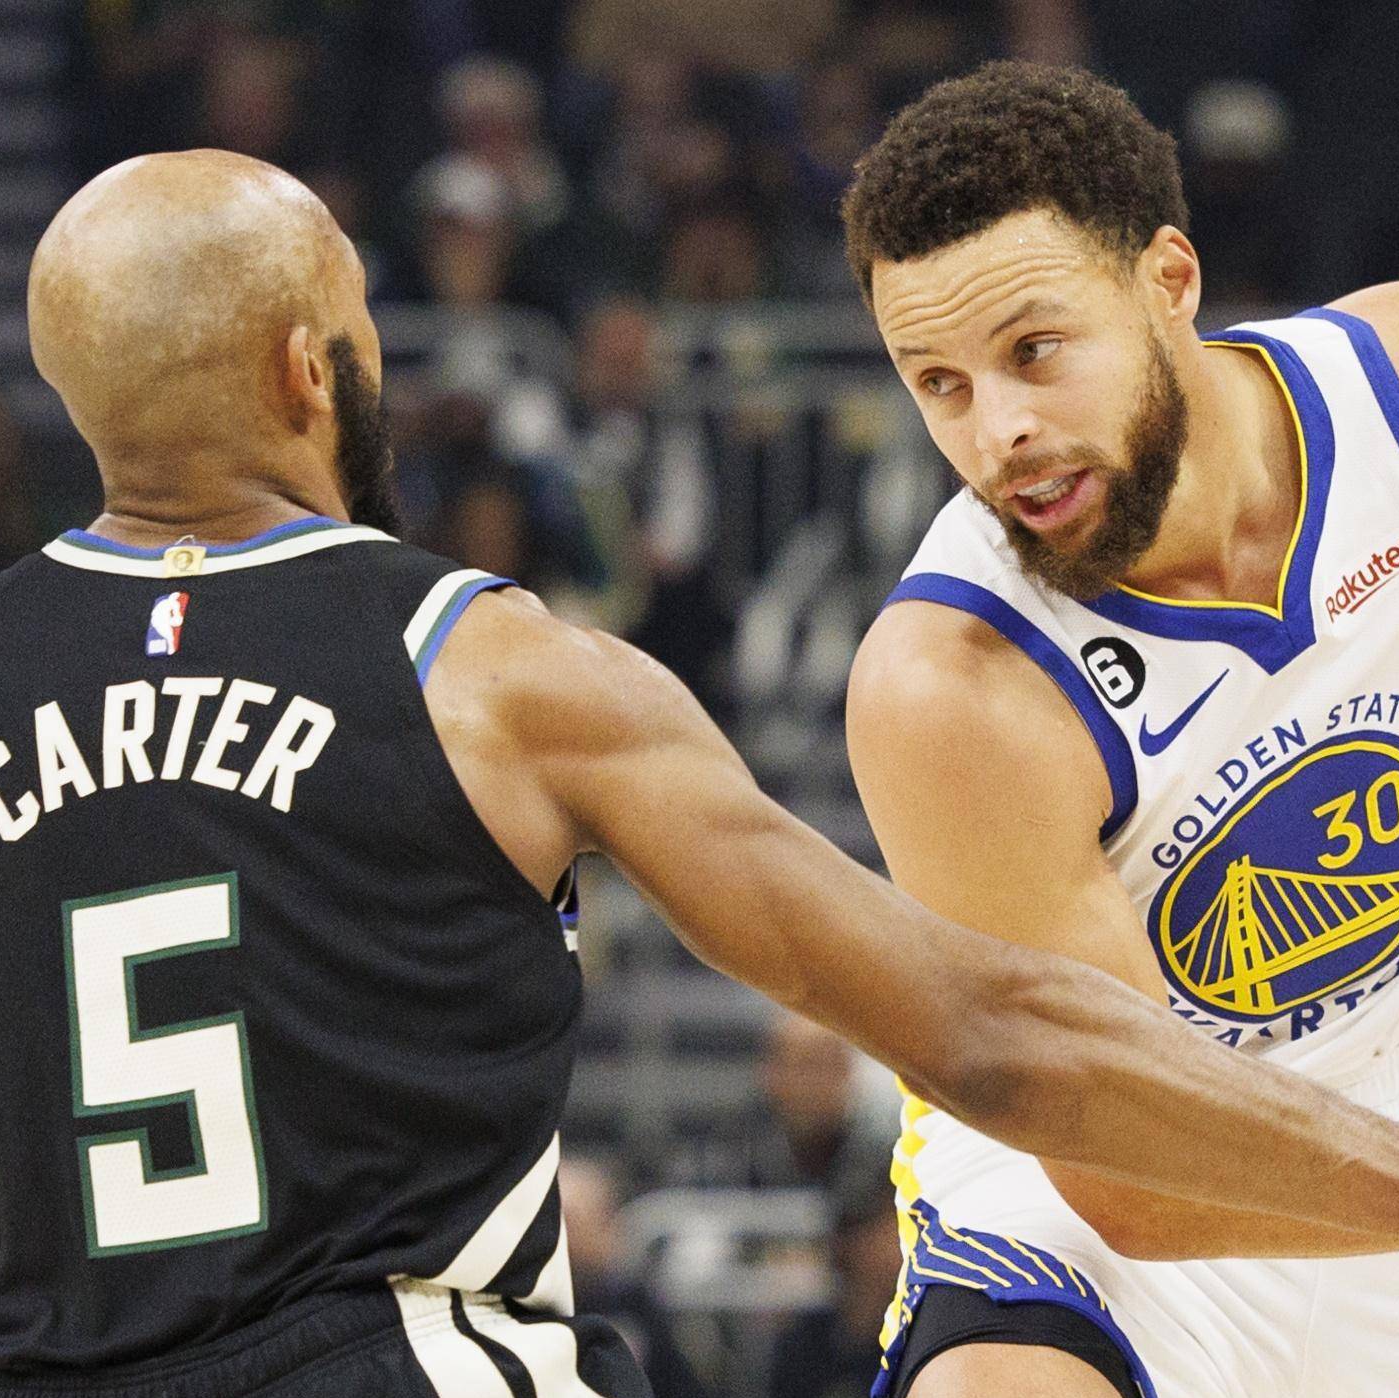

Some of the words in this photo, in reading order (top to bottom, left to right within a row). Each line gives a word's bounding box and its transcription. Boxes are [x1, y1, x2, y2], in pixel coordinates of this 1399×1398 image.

[1088, 646, 1135, 703] 6
[1151, 718, 1308, 870] GOLDEN
[61, 870, 269, 1260] 5
